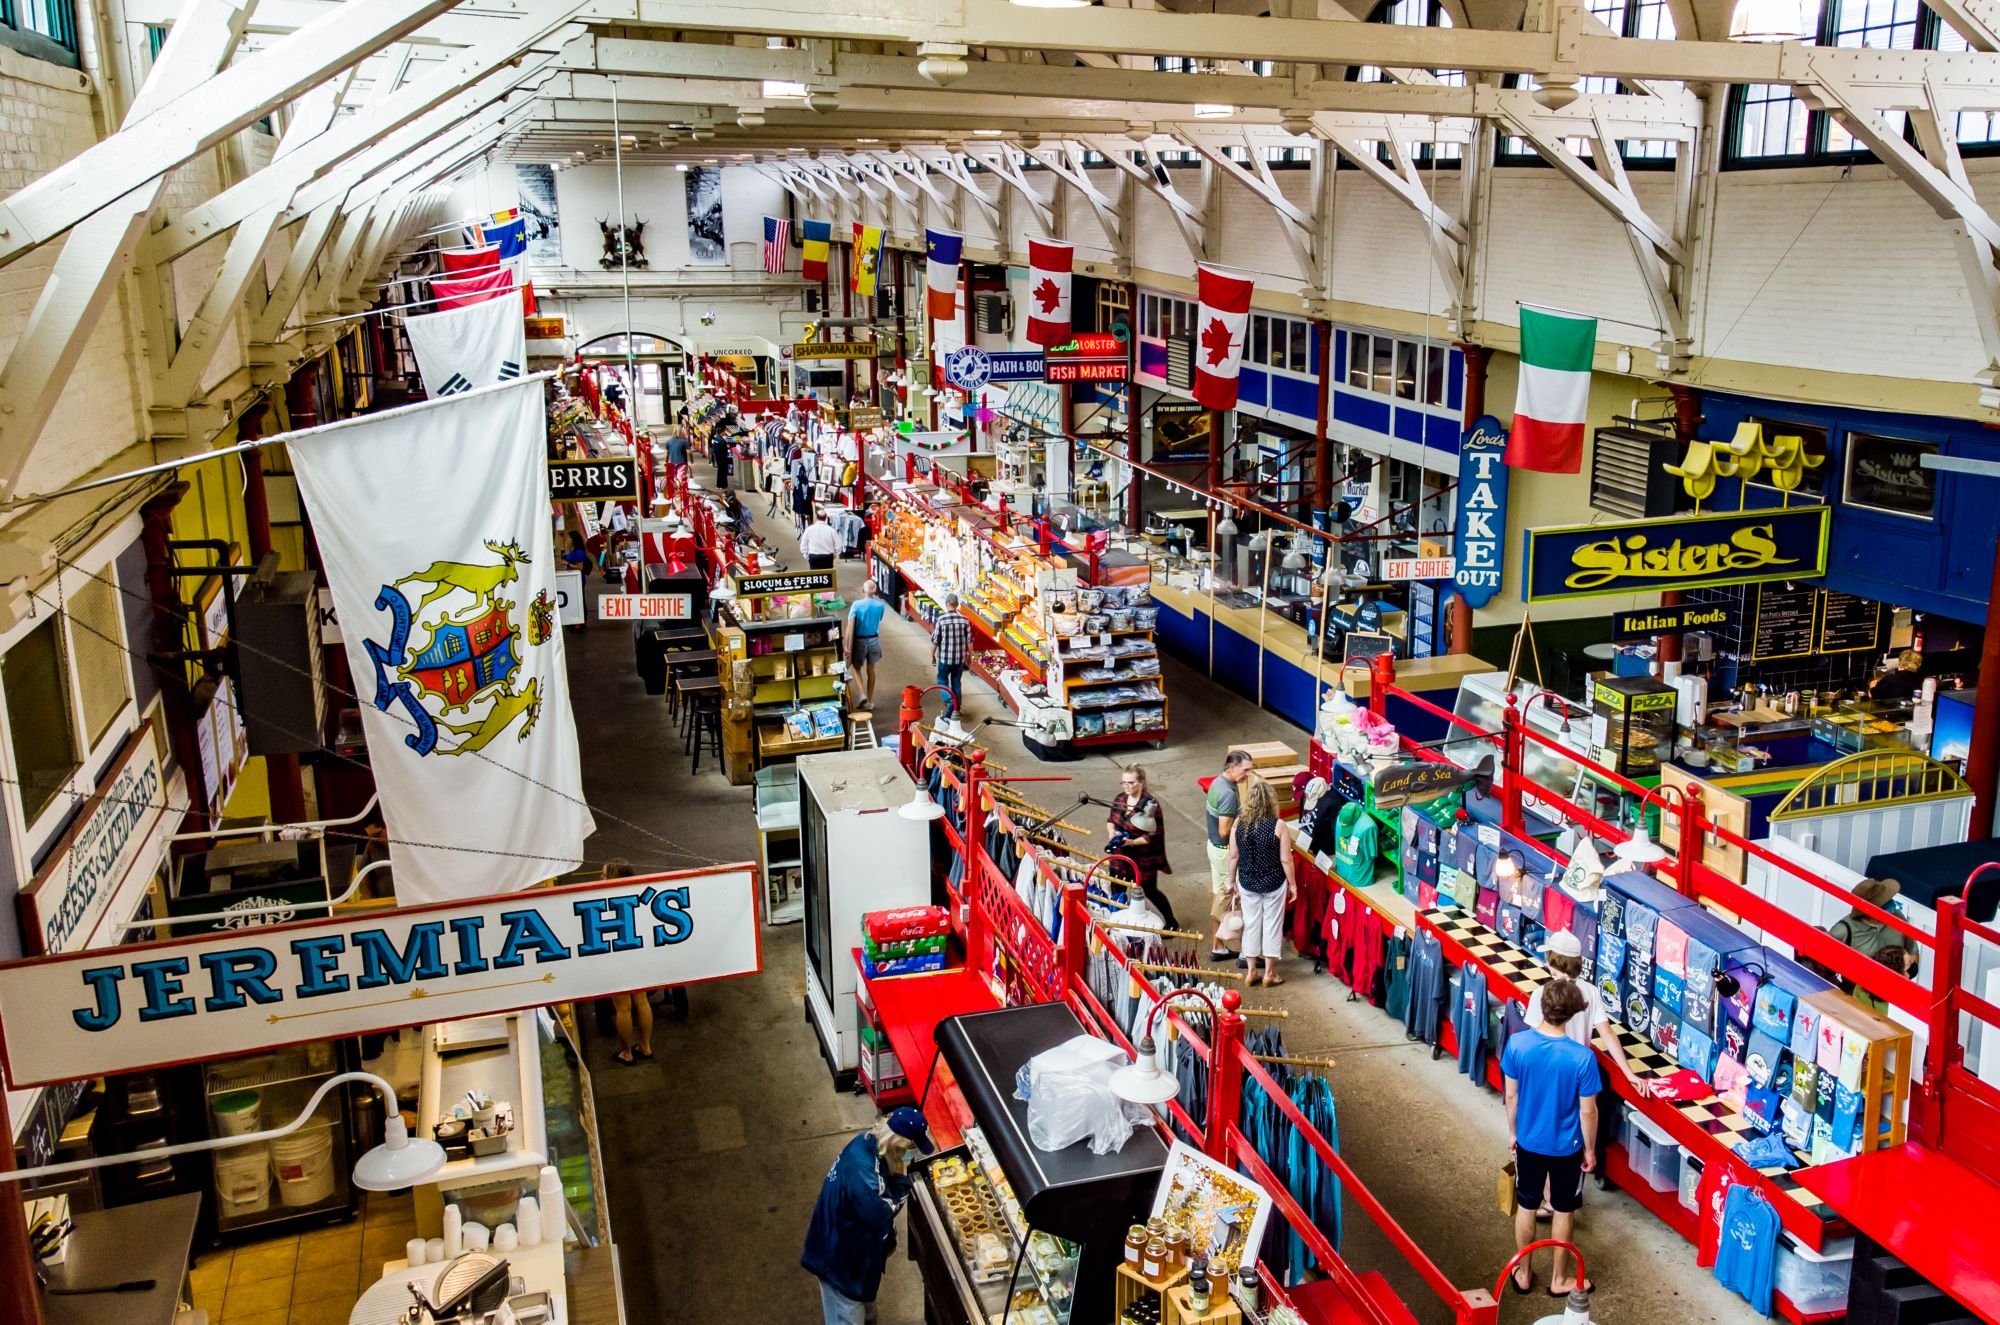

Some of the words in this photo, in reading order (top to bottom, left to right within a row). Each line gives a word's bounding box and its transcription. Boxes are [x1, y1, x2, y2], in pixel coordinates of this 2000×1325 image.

[797, 345, 850, 357] SHAWARMA
[854, 345, 874, 355] HUT
[1080, 340, 1116, 350] LOBSTER
[993, 361, 1018, 374] BATH
[1018, 362, 1025, 372] &
[1050, 366, 1076, 380] FISH
[1080, 365, 1127, 380] MARKET
[1463, 428, 1506, 450] Lord's
[1463, 452, 1501, 567] TAKE
[1389, 562, 1410, 578] EXIT
[1415, 560, 1450, 577] SORTIE
[1456, 569, 1500, 587] OUT
[744, 579, 782, 591] SLOCUM
[783, 578, 792, 586] &
[792, 575, 829, 586] FERRIS
[606, 598, 632, 617] EXIT
[640, 598, 684, 617] SORTIE
[1623, 615, 1677, 632] Italian
[1683, 609, 1727, 626] Foods
[1597, 688, 1622, 707] PIZZA
[1634, 695, 1673, 709] PIZZA
[1382, 772, 1413, 793] Land
[1418, 770, 1427, 781] &
[1433, 769, 1452, 780] Sea
[72, 815, 104, 869] Jeremiah
[46, 855, 99, 955] CHEESES
[98, 810, 130, 879] SLICED
[128, 757, 158, 833] MEATS
[901, 926, 925, 936] Coca-Cola
[72, 886, 694, 1033] JEREMIAH'S
